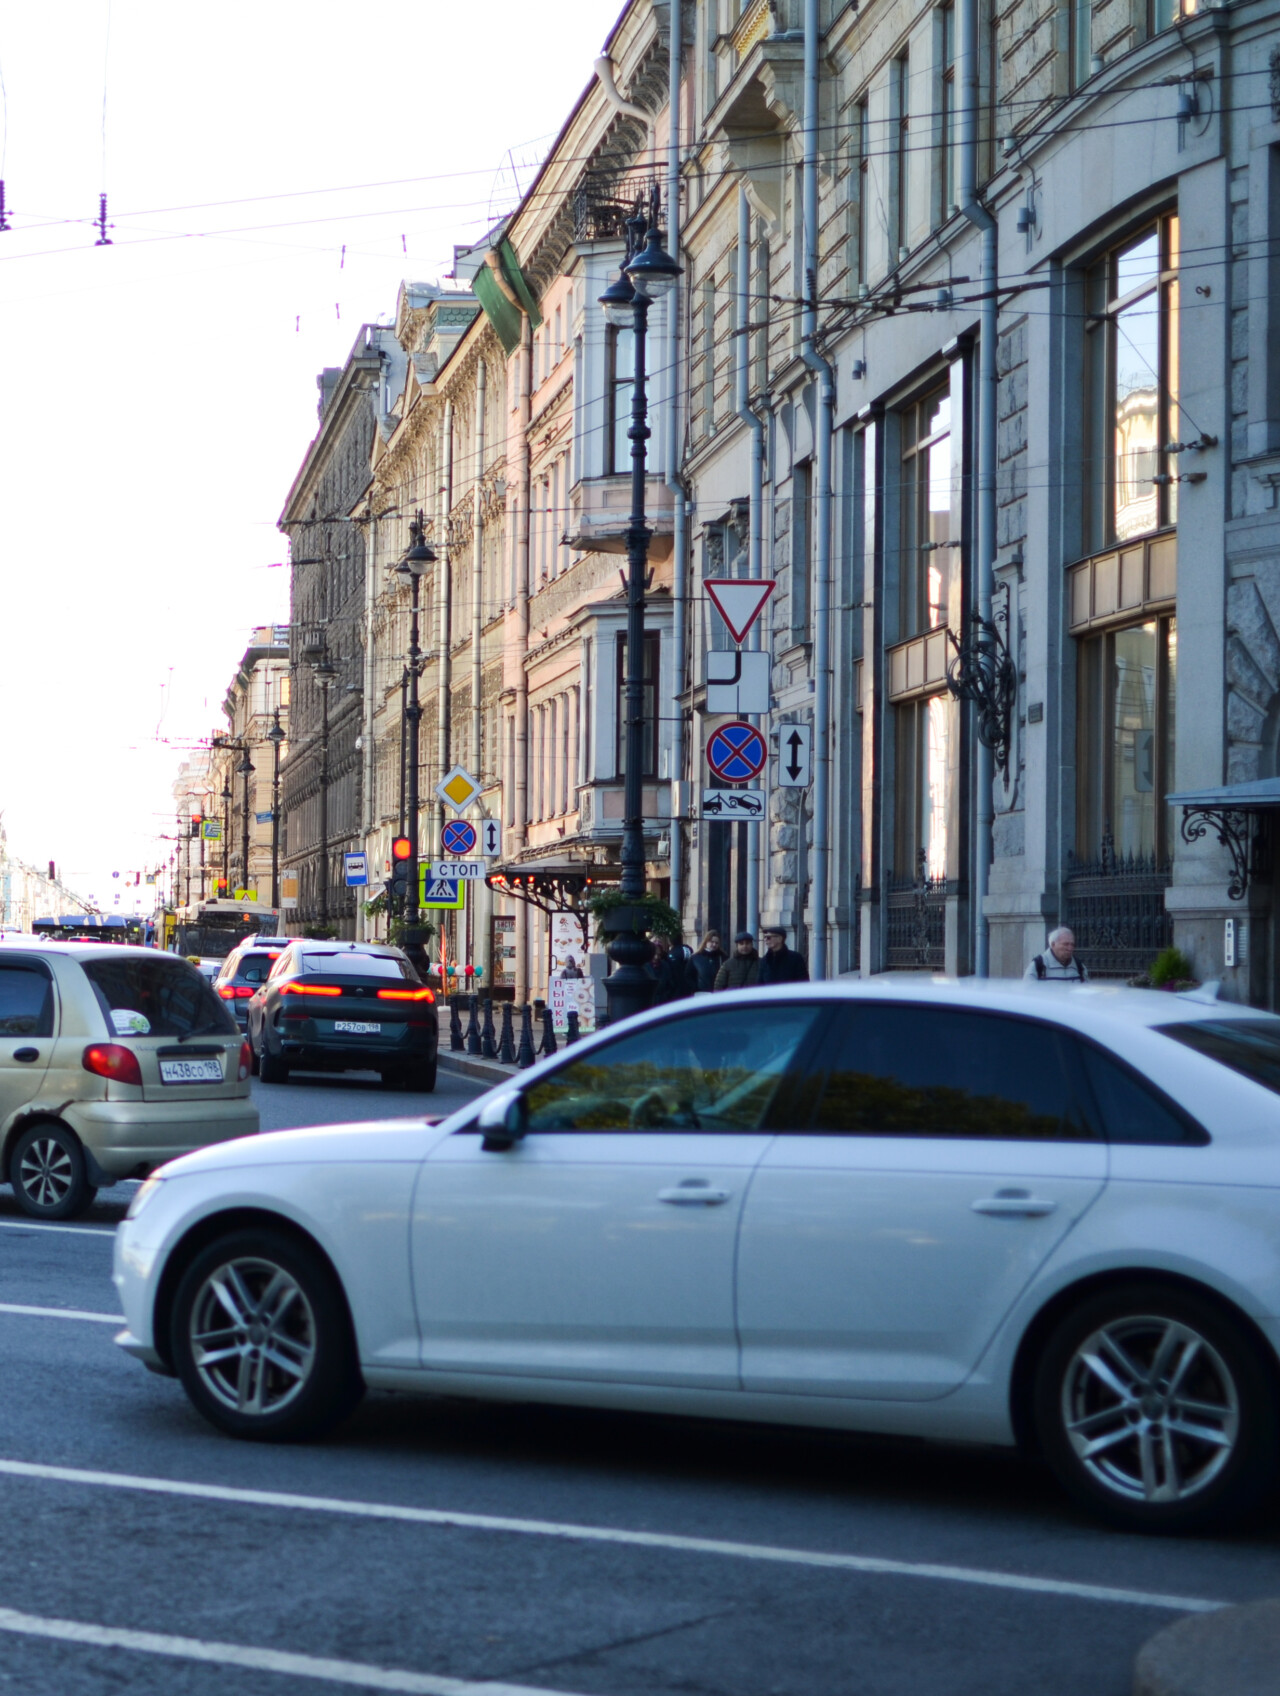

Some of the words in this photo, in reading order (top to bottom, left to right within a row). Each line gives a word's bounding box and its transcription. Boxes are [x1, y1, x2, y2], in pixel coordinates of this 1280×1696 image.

[439, 864, 478, 876] СТОП
[242, 913, 250, 922] 2
[553, 980, 565, 1027] ПЫШКИ
[164, 1063, 204, 1079] Н438СО
[204, 1061, 219, 1073] 198
